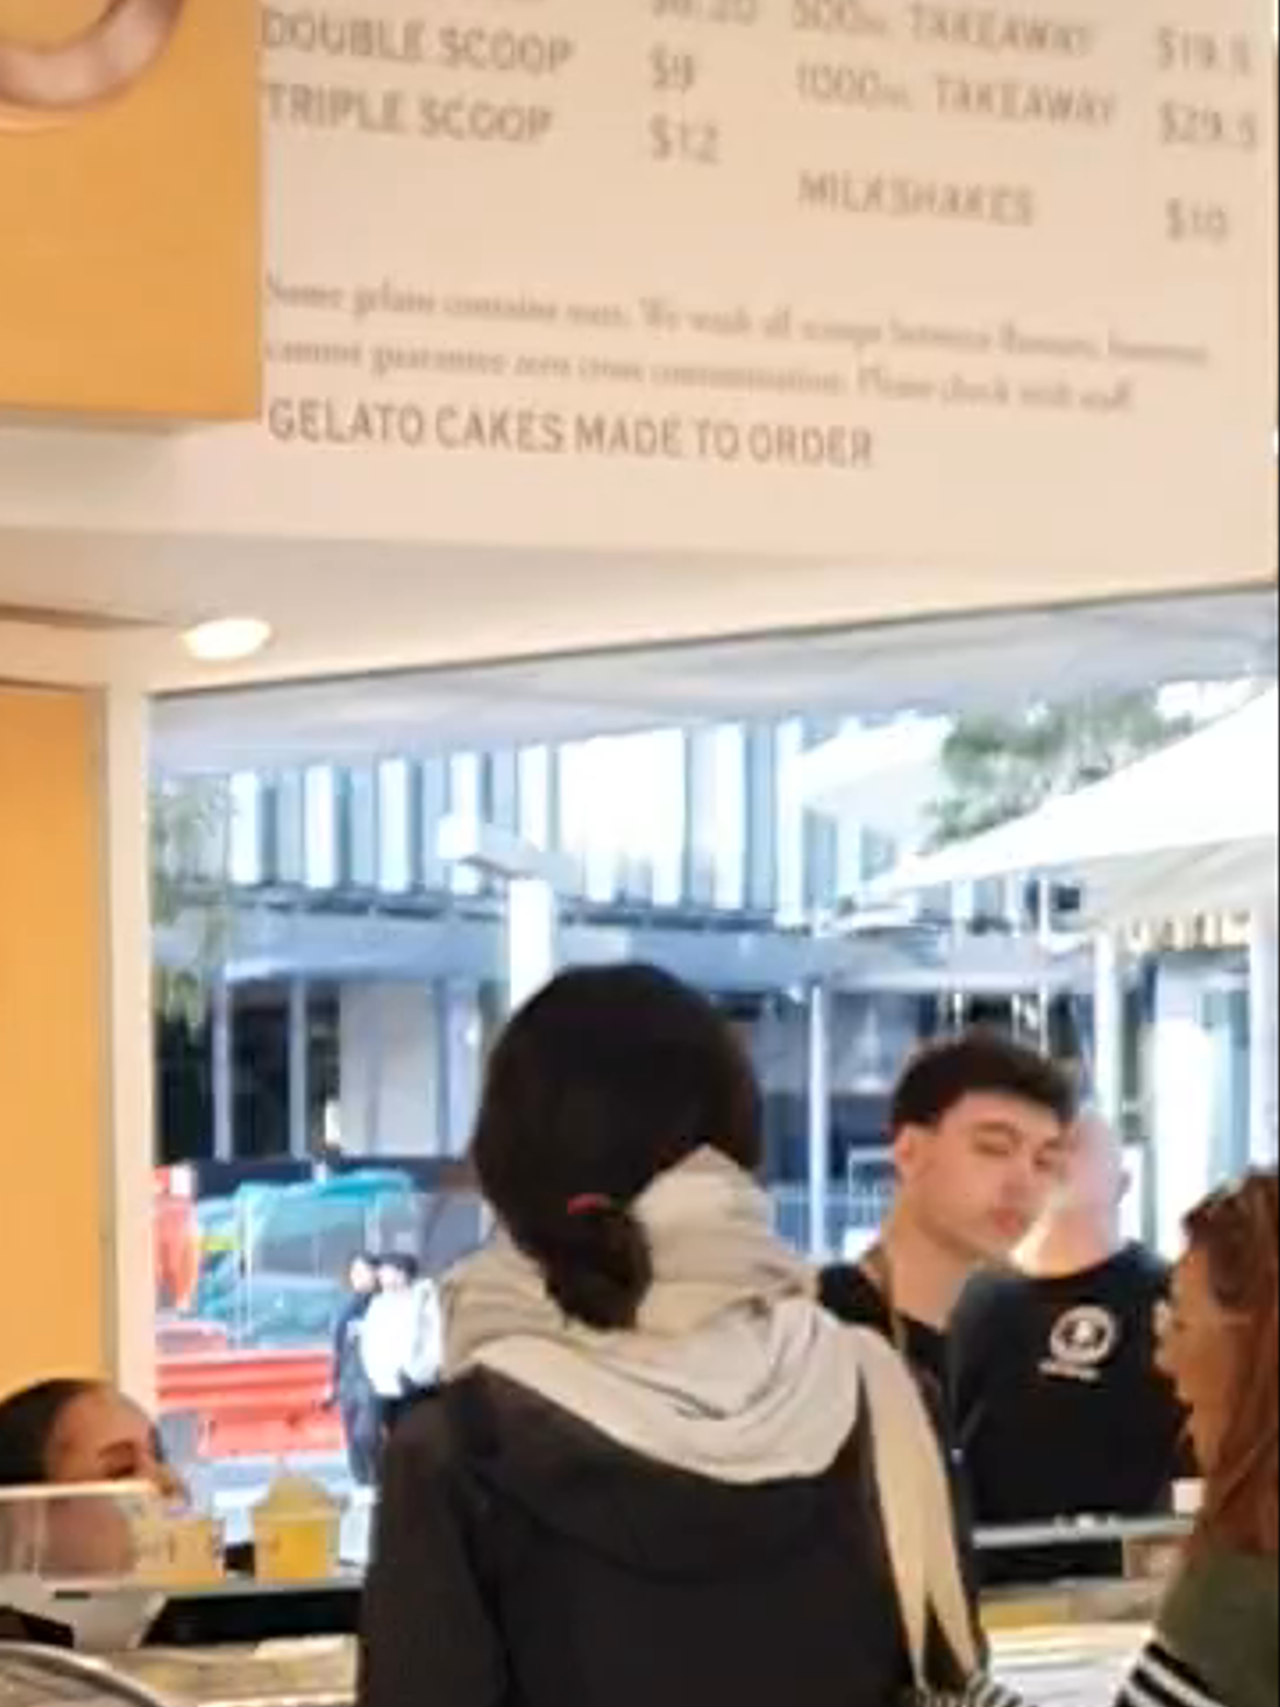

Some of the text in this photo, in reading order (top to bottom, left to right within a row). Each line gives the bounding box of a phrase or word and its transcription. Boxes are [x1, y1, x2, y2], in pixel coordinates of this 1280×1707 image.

[261, 7, 426, 65] DOUBLE
[440, 26, 573, 77] SCOOP
[263, 80, 721, 166] TRIPLE SCOOP $12
[934, 74, 1116, 126] TAKEAWAY
[798, 168, 1034, 226] MILKSHAKES
[268, 397, 873, 469] GELATO CAKES MADE TO ORDER
